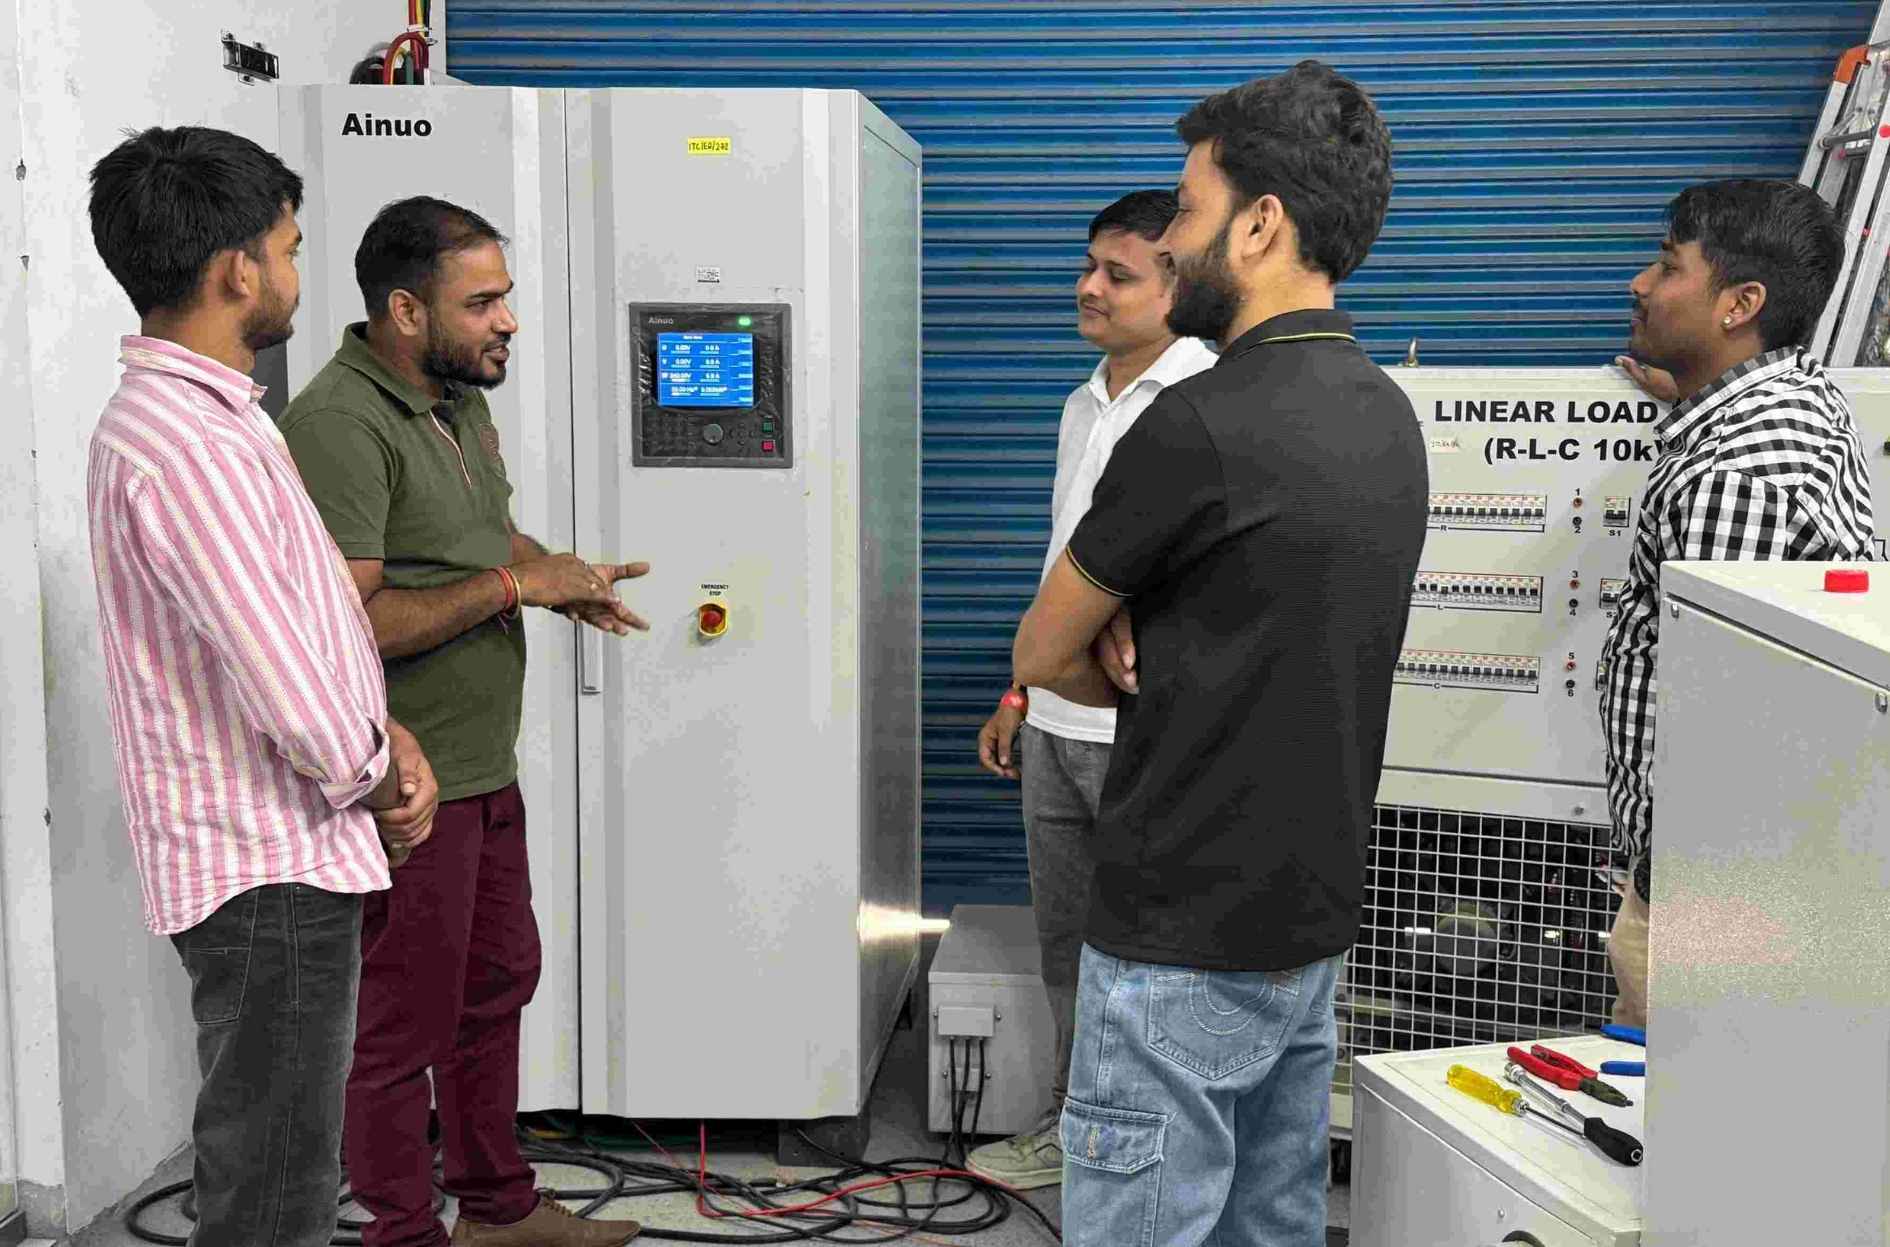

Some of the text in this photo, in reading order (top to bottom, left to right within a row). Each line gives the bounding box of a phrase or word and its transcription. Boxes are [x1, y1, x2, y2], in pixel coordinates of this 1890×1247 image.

[341, 112, 432, 137] Ainuo
[1435, 400, 1658, 424] LINEAR LOAD
[1484, 437, 1581, 465] (R-L-C
[1575, 487, 1581, 497] 1
[1440, 524, 1448, 532] R
[1574, 526, 1582, 534] 2
[1608, 529, 1622, 537] S1
[1571, 570, 1579, 579] 3
[1569, 608, 1577, 617] 4
[1568, 651, 1575, 660] 5
[1567, 689, 1574, 698] 6
